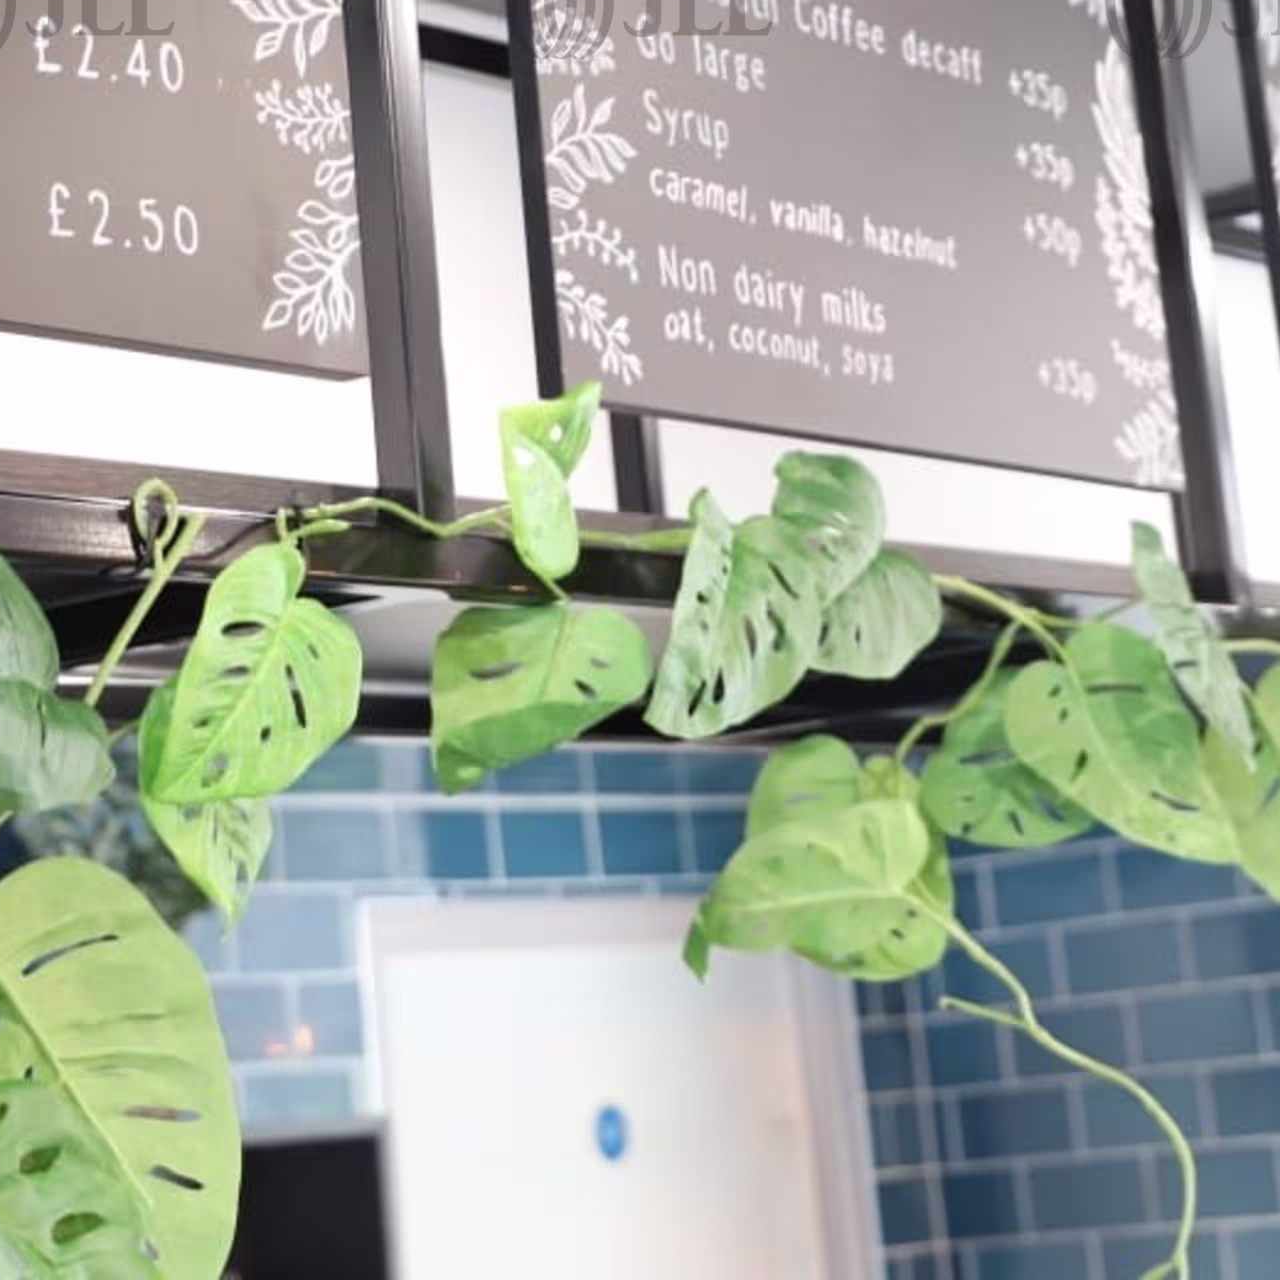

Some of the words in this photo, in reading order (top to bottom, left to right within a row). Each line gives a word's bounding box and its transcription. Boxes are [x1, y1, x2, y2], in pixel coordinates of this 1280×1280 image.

[33, 15, 184, 93] £2.40
[635, 12, 676, 65] Go
[692, 35, 766, 93] large
[901, 29, 982, 85] decaff
[642, 88, 729, 160] Syrup
[47, 182, 199, 256] £2.50
[863, 215, 957, 269] hazelnut
[657, 244, 717, 295] Non
[733, 264, 804, 327] dairy
[821, 287, 887, 334] milks
[842, 344, 894, 385] soya
